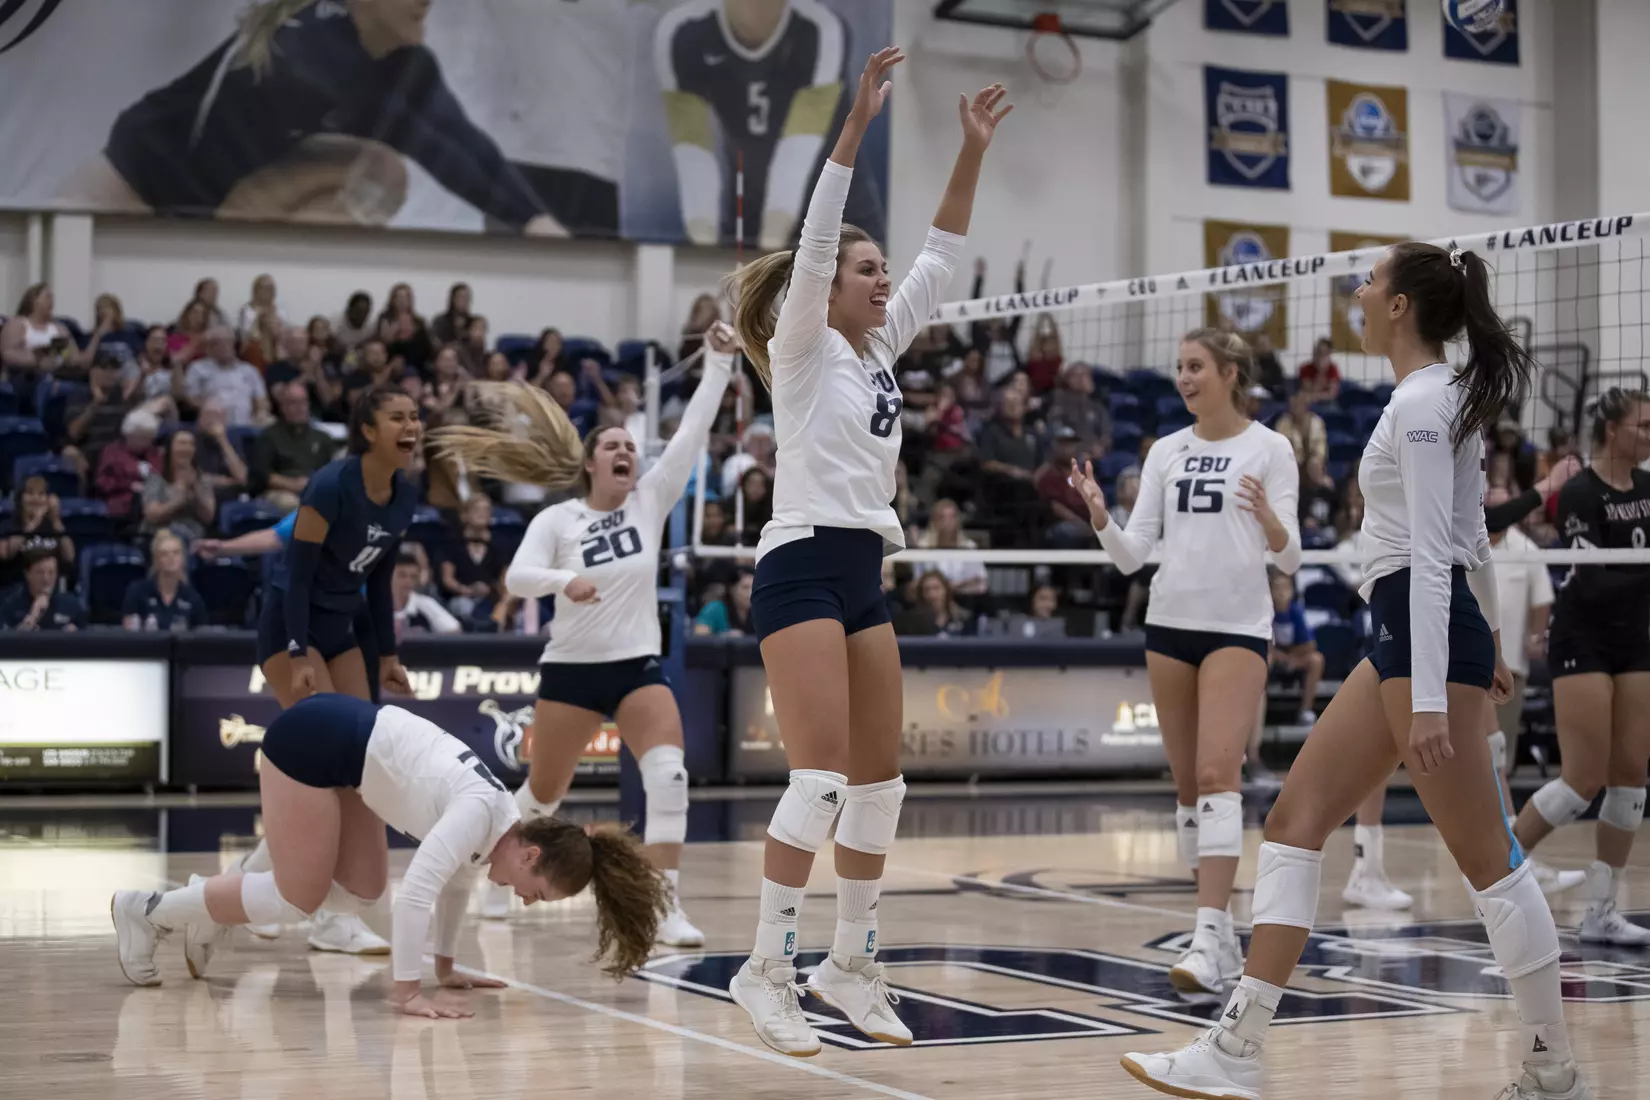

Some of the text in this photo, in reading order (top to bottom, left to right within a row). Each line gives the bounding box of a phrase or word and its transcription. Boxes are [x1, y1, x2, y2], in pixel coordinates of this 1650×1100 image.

[747, 82, 771, 135] 5
[1209, 256, 1325, 286] #LANCEUP
[1486, 216, 1633, 250] #LANCEUP
[870, 393, 903, 438] 8
[1407, 430, 1438, 443] WAC
[1184, 456, 1232, 473] CBU
[1175, 478, 1226, 513] 15
[580, 526, 643, 568] 20
